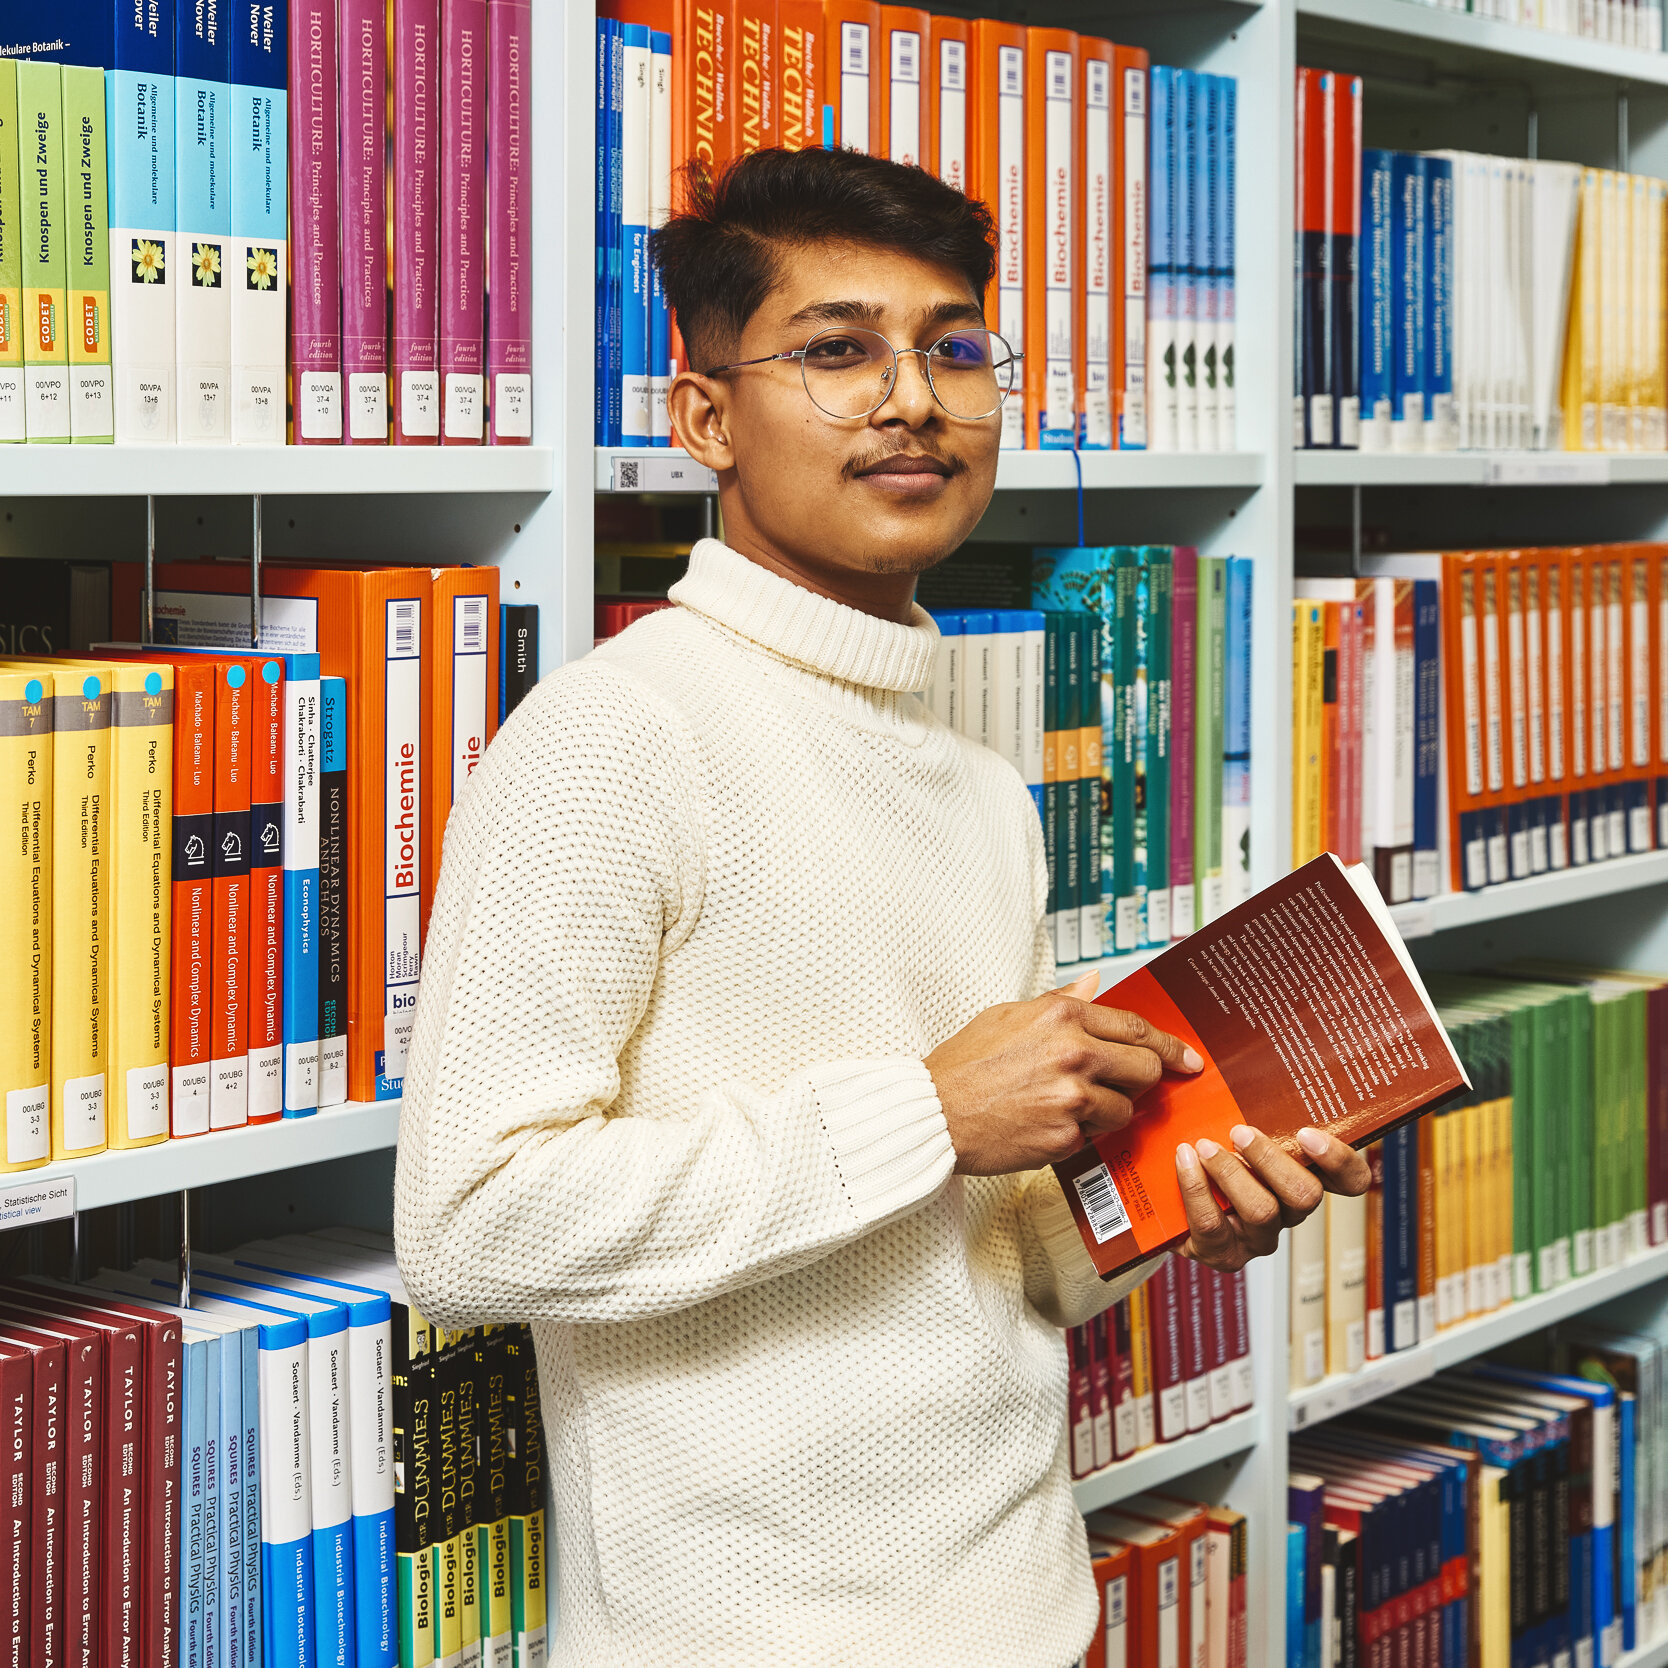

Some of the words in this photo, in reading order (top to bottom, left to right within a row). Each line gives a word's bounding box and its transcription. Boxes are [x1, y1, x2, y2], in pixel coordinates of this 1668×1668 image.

[32, 39, 64, 52] Botanik
[250, 4, 260, 46] Nover
[263, 6, 273, 53] Weiler
[310, 11, 323, 155] HORTICULTURE:
[362, 19, 373, 160] HORTICULTURE:
[415, 24, 425, 164] HORTICULTURE:
[137, 83, 148, 139] Botanik
[197, 90, 207, 146] Botanik
[253, 97, 262, 151] Botanik
[35, 112, 49, 164] Zweige
[80, 117, 93, 168] Zweige
[37, 169, 48, 197] und
[81, 173, 92, 200] und
[311, 161, 323, 222] Principles
[361, 166, 373, 225] Principles
[413, 169, 424, 228] Principles
[39, 202, 51, 263] Knospen
[83, 204, 95, 266] Knospen
[313, 224, 323, 247] and
[364, 228, 373, 251] and
[415, 231, 424, 253] and
[1006, 166, 1018, 282] Biochemie
[1054, 168, 1066, 283] Biochemie
[1094, 175, 1104, 287] Biochemie
[1132, 180, 1143, 293] Biochemie
[313, 252, 323, 305] Practices
[365, 256, 373, 307] Practices
[415, 258, 424, 309] Practices
[40, 302, 50, 343] GODET
[85, 304, 94, 345] GODET
[308, 339, 332, 350] fourth
[309, 349, 332, 358] edition
[35, 381, 61, 389] 00/VPO
[40, 393, 57, 401] 6+12
[80, 380, 105, 388] 00/VPO
[85, 391, 101, 399] 6+13
[671, 471, 683, 479] UBX
[517, 628, 527, 673] Smith
[21, 705, 41, 717] TAM
[29, 718, 35, 728] 7
[143, 697, 163, 708] TAM
[150, 709, 156, 718] 7
[194, 691, 203, 727] Machado
[298, 697, 306, 756] Chakraborti
[194, 733, 202, 765] Baleanu
[323, 697, 335, 763] Strogatz
[27, 751, 36, 785] Perko
[87, 745, 96, 779] Perko
[148, 741, 157, 774] Perko
[194, 771, 202, 786] Luo
[306, 734, 315, 786] Chatterjee
[153, 789, 162, 850] Differential
[298, 765, 306, 824] Chakrabarti
[394, 743, 414, 888] Biochemie
[32, 801, 41, 863] Differential
[320, 837, 329, 874] AND
[330, 788, 339, 888] NONLINEAR
[31, 867, 40, 925] Equations
[152, 853, 161, 909] Equations
[153, 913, 161, 934] and
[192, 888, 202, 937] Nonlinear
[301, 879, 310, 954] Econophysics
[321, 879, 329, 936] CHAOS
[32, 929, 40, 951] and
[191, 940, 201, 960] and
[331, 894, 340, 983] DYNAMICS
[1352, 934, 1363, 951] Smith
[1361, 949, 1369, 960] has
[31, 954, 41, 1015] Dynamical
[152, 937, 161, 996] Dynamical
[190, 961, 202, 1006] Complex
[1366, 958, 1380, 979] written
[1376, 977, 1383, 985] an
[152, 999, 161, 1049] Systems
[393, 993, 416, 1009] bio
[1392, 1005, 1401, 1013] of
[31, 1018, 41, 1070] Systems
[188, 1008, 201, 1058] Dynamics
[1411, 1039, 1420, 1048] of
[1415, 1047, 1430, 1071] thinking
[150, 1092, 160, 1100] 3-3
[4, 1193, 47, 1208] Statistische
[49, 1189, 67, 1199] Sicht
[1113, 1154, 1136, 1198] UNIVERSITY
[1134, 1199, 1146, 1221] PRESS
[1120, 1150, 1155, 1218] CAMBRIDGE
[25, 1206, 42, 1215] view
[48, 1383, 57, 1450] TAYLOR
[124, 1366, 133, 1432] TAYLOR
[167, 1359, 175, 1424] TAYLOR
[14, 1393, 23, 1461] TAYLOR
[293, 1411, 301, 1468] Vandamme
[228, 1435, 238, 1485] SQUIRES
[412, 1399, 430, 1522] DUMMIES
[165, 1480, 173, 1497] An
[292, 1472, 302, 1501] (Eds.)
[164, 1500, 172, 1573] Introduction
[229, 1491, 240, 1545] Practical
[379, 1520, 389, 1573] Industrial
[463, 1532, 476, 1605] Biologie
[164, 1576, 171, 1589] to
[228, 1550, 241, 1600] Physics
[417, 1553, 430, 1629] Biologie
[444, 1543, 457, 1618] Biologie
[164, 1592, 173, 1624] Error
[380, 1576, 390, 1651] Biotechnology
